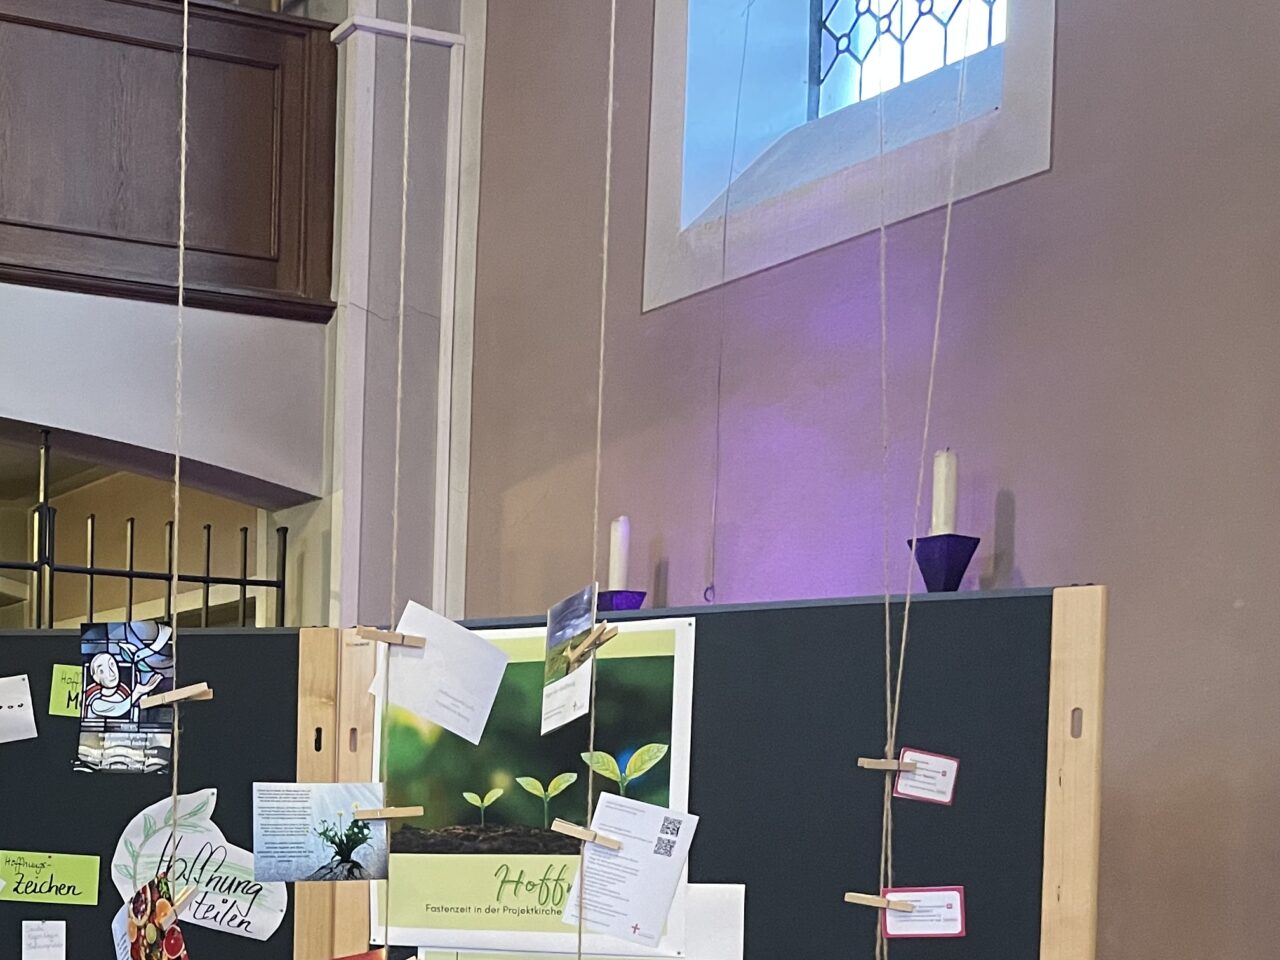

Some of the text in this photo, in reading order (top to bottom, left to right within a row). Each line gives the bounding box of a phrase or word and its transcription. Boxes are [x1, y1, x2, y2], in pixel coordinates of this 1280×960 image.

[12, 872, 83, 896] Zeichen
[155, 831, 264, 918] Hoffnung
[192, 890, 254, 934] teilen
[425, 903, 563, 917] Fastenzeit in der Projektkirche
